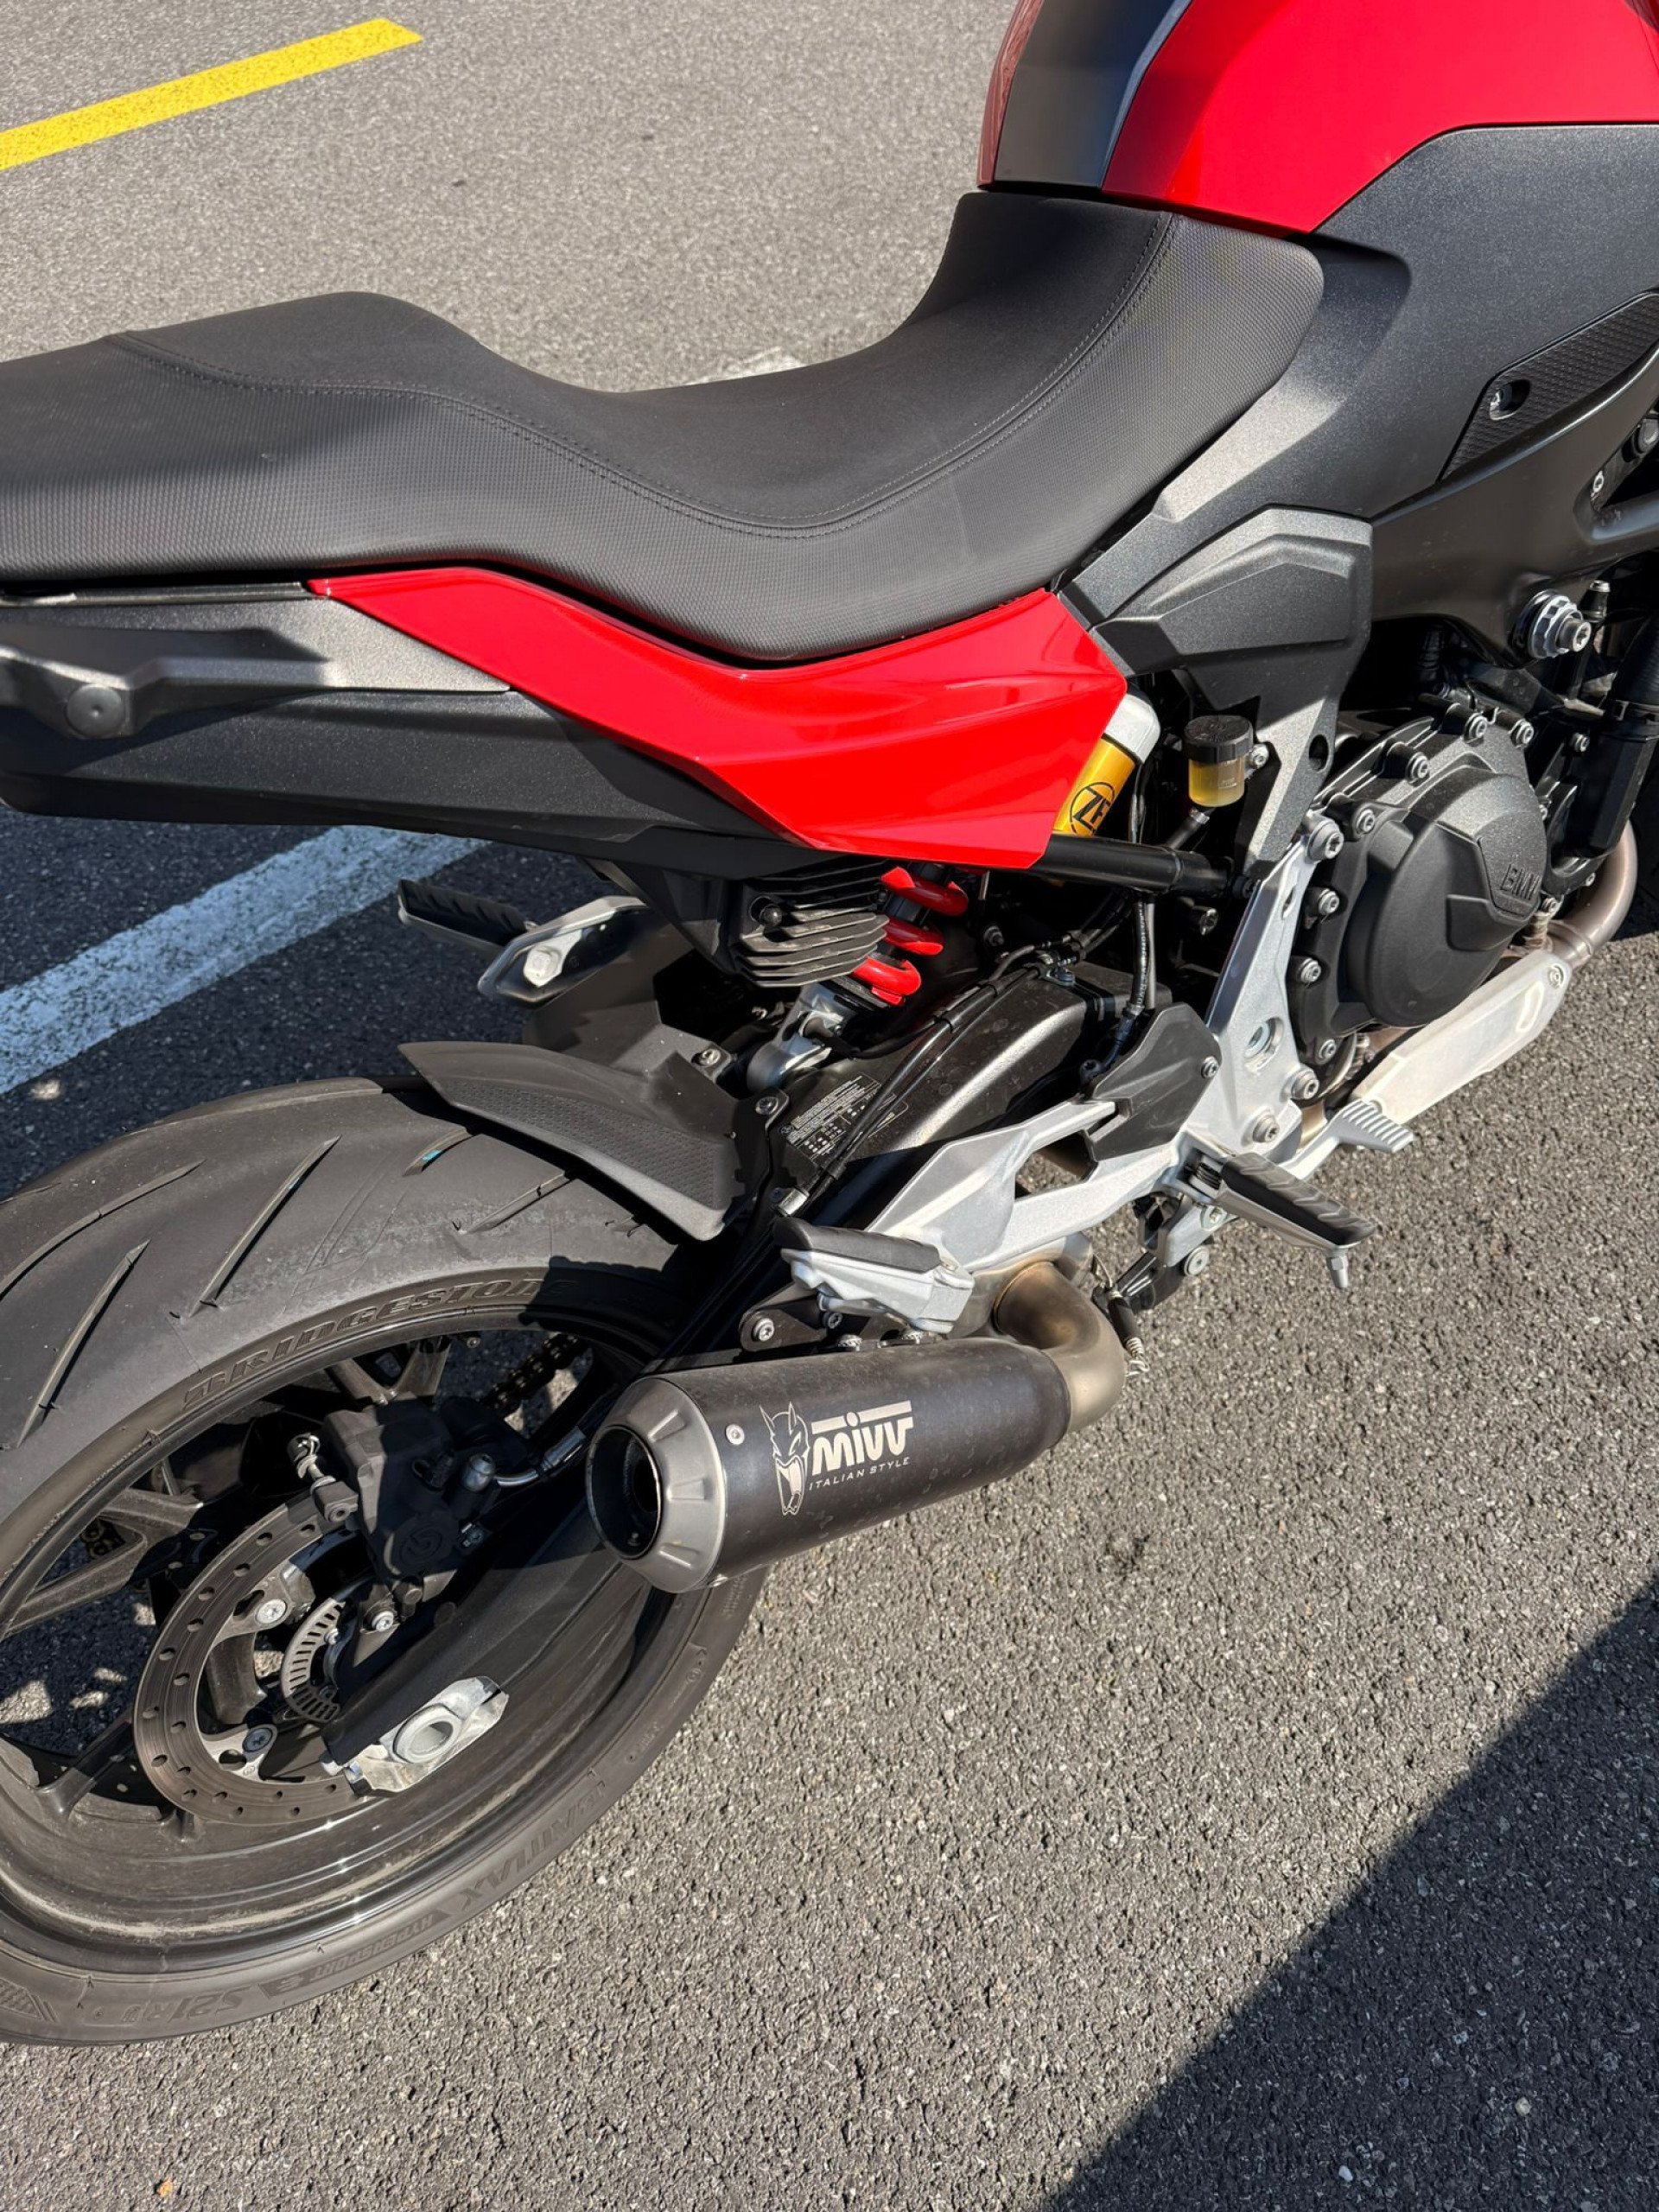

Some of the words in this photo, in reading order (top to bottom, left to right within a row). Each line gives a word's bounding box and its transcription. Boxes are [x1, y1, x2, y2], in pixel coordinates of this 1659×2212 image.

[1071, 784, 1111, 832] ZF
[181, 1277, 577, 1412] BRIDGESTONE
[809, 1469, 865, 1491] ITALIAN
[869, 1457, 911, 1475] STYLE
